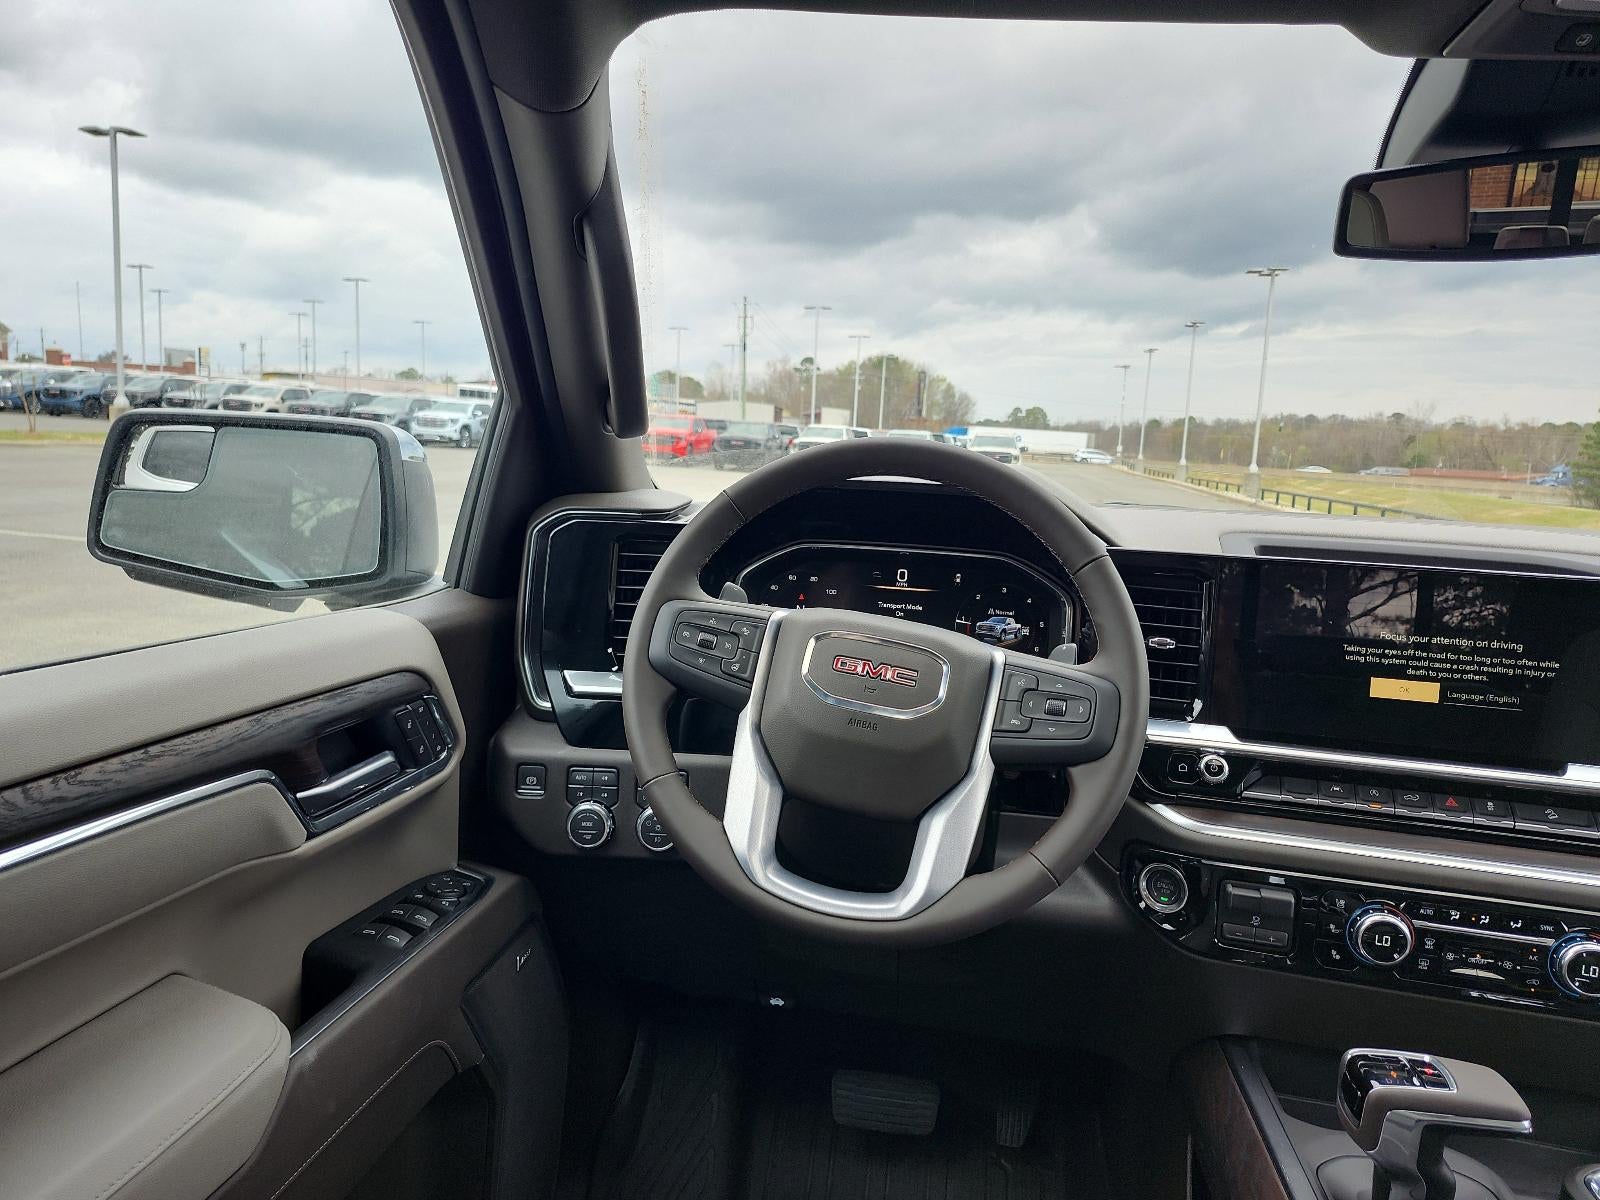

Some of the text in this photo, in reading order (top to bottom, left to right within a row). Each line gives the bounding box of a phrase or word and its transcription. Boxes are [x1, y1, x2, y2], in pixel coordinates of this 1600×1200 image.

[897, 568, 908, 582] 0
[877, 601, 923, 611] Transport Mode
[1380, 631, 1524, 653] Focus your attention on driving
[1343, 644, 1366, 654] Taking
[1367, 647, 1384, 655] your
[1384, 649, 1401, 657] eyes
[1402, 649, 1415, 657] off
[1428, 652, 1446, 660] road
[1474, 654, 1491, 664] long
[1502, 657, 1515, 665] too
[1517, 658, 1538, 667] often
[1540, 660, 1560, 669] while
[832, 654, 919, 688] GMC
[1345, 654, 1365, 663] using
[1366, 654, 1380, 663] this
[1381, 658, 1407, 666] system
[1408, 659, 1428, 667] could
[1459, 663, 1479, 671] crash
[1480, 665, 1513, 676] resulting
[1523, 668, 1546, 679] injury
[1406, 667, 1428, 676] death
[1437, 671, 1451, 679] you
[1462, 673, 1489, 681] others.
[1447, 690, 1520, 705] Language (English)
[847, 717, 878, 731] AIRBAG
[1419, 908, 1434, 916] AUTO
[1540, 924, 1554, 932] SYNC
